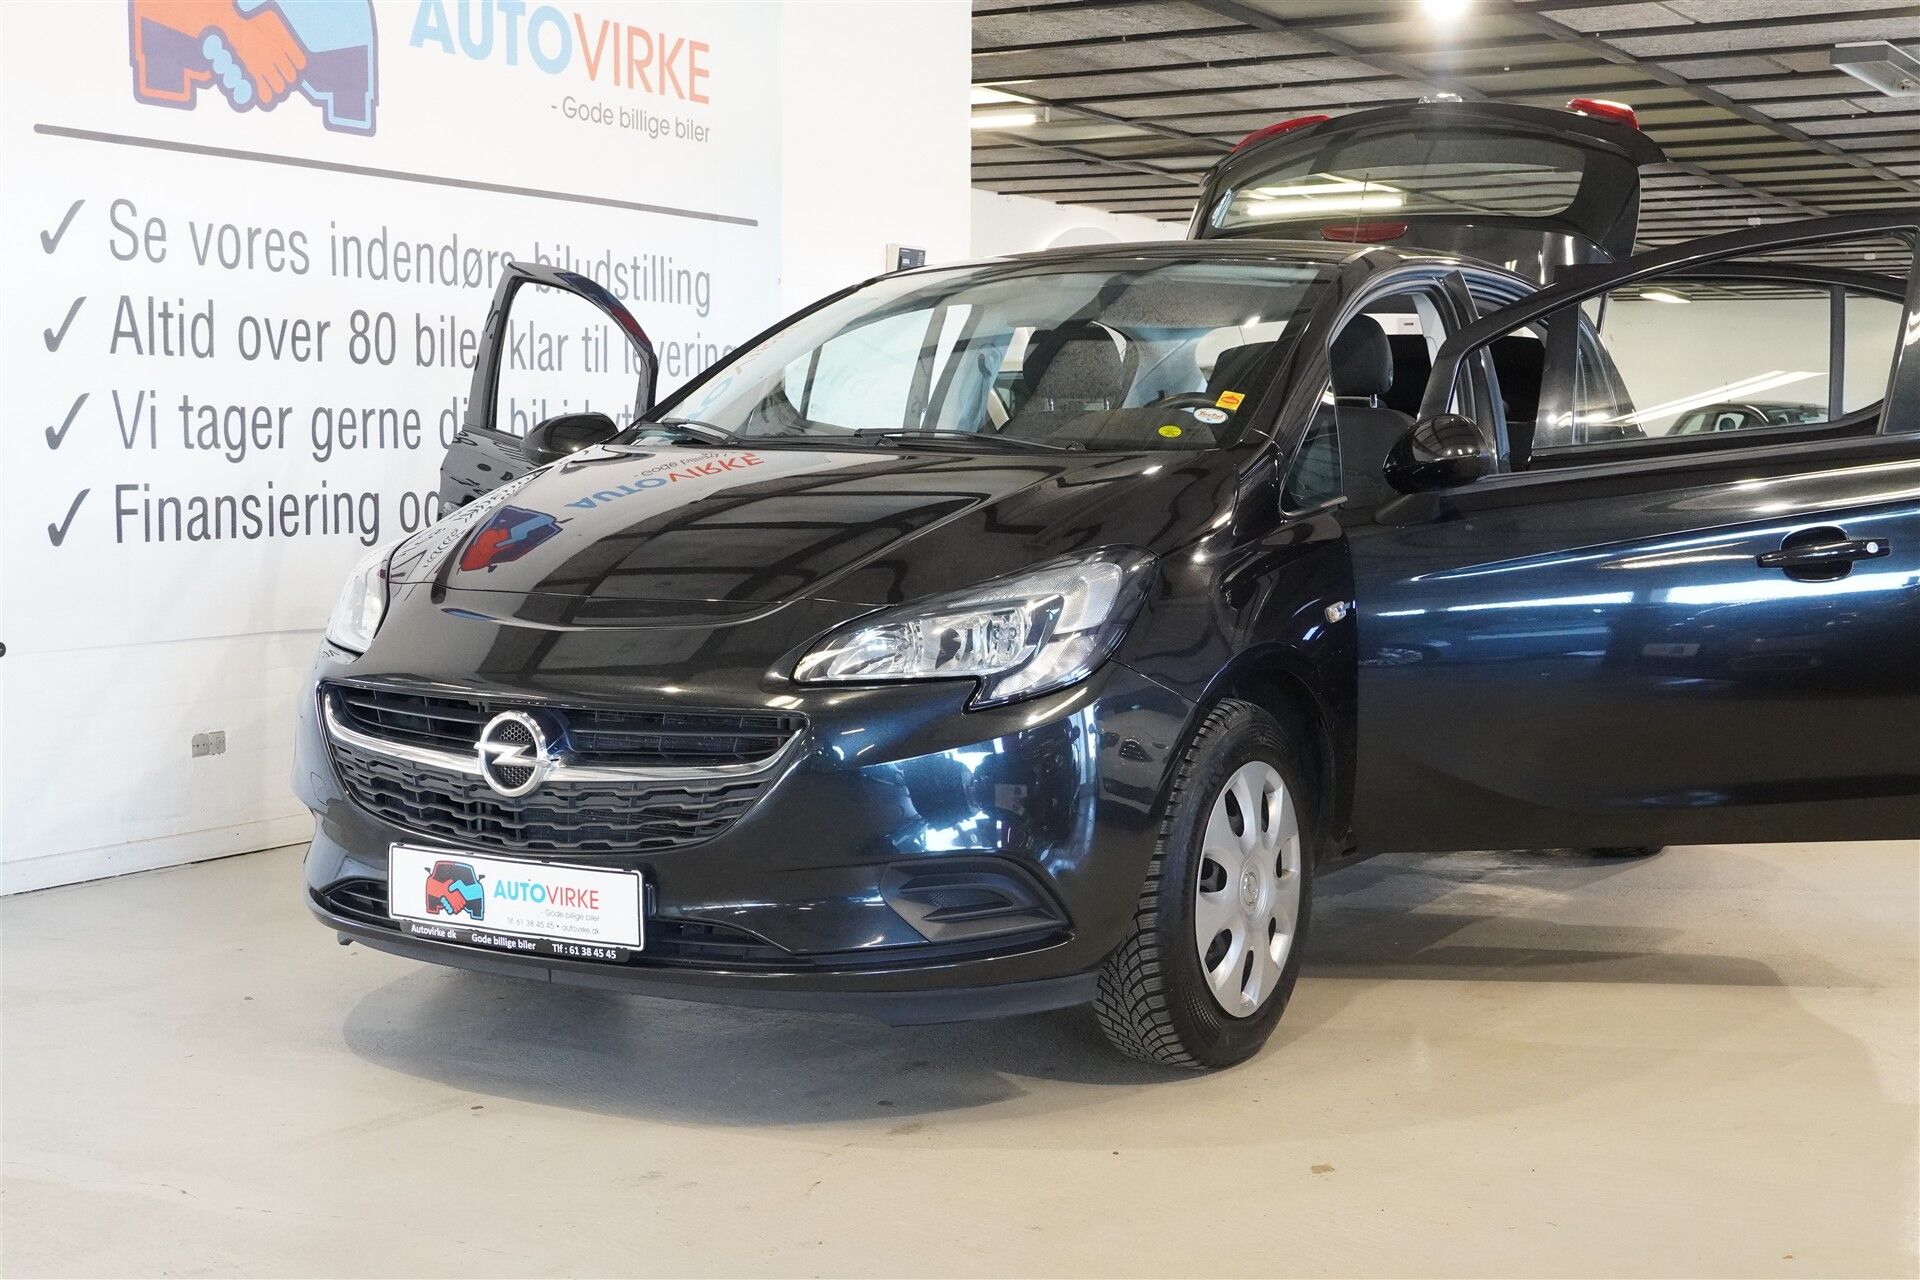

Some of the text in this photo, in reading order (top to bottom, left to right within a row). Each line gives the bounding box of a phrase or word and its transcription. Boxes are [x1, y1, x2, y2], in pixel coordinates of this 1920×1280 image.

[409, 0, 709, 105] AUTOVIRKE
[562, 95, 614, 125] Gode
[619, 106, 670, 139] billige
[675, 117, 710, 143] biler
[109, 198, 167, 262] Se
[188, 221, 310, 275] vores
[109, 295, 215, 359] Altid
[238, 315, 331, 362] over
[349, 309, 396, 366] 80
[509, 319, 569, 373] klar
[581, 325, 608, 374] til
[111, 389, 157, 450] Vi
[178, 395, 293, 464] tager
[311, 406, 421, 463] gerne
[115, 480, 380, 547] Finansiering
[493, 879, 599, 910] AUTOVIRKE
[545, 909, 564, 918] Gode
[410, 924, 446, 938] Autovirke
[471, 933, 492, 945] Gode
[493, 936, 517, 949] billige
[517, 939, 537, 951] biler
[569, 945, 580, 955] 61
[581, 947, 592, 957] 38
[593, 948, 604, 958] 45
[605, 949, 617, 960] 45
